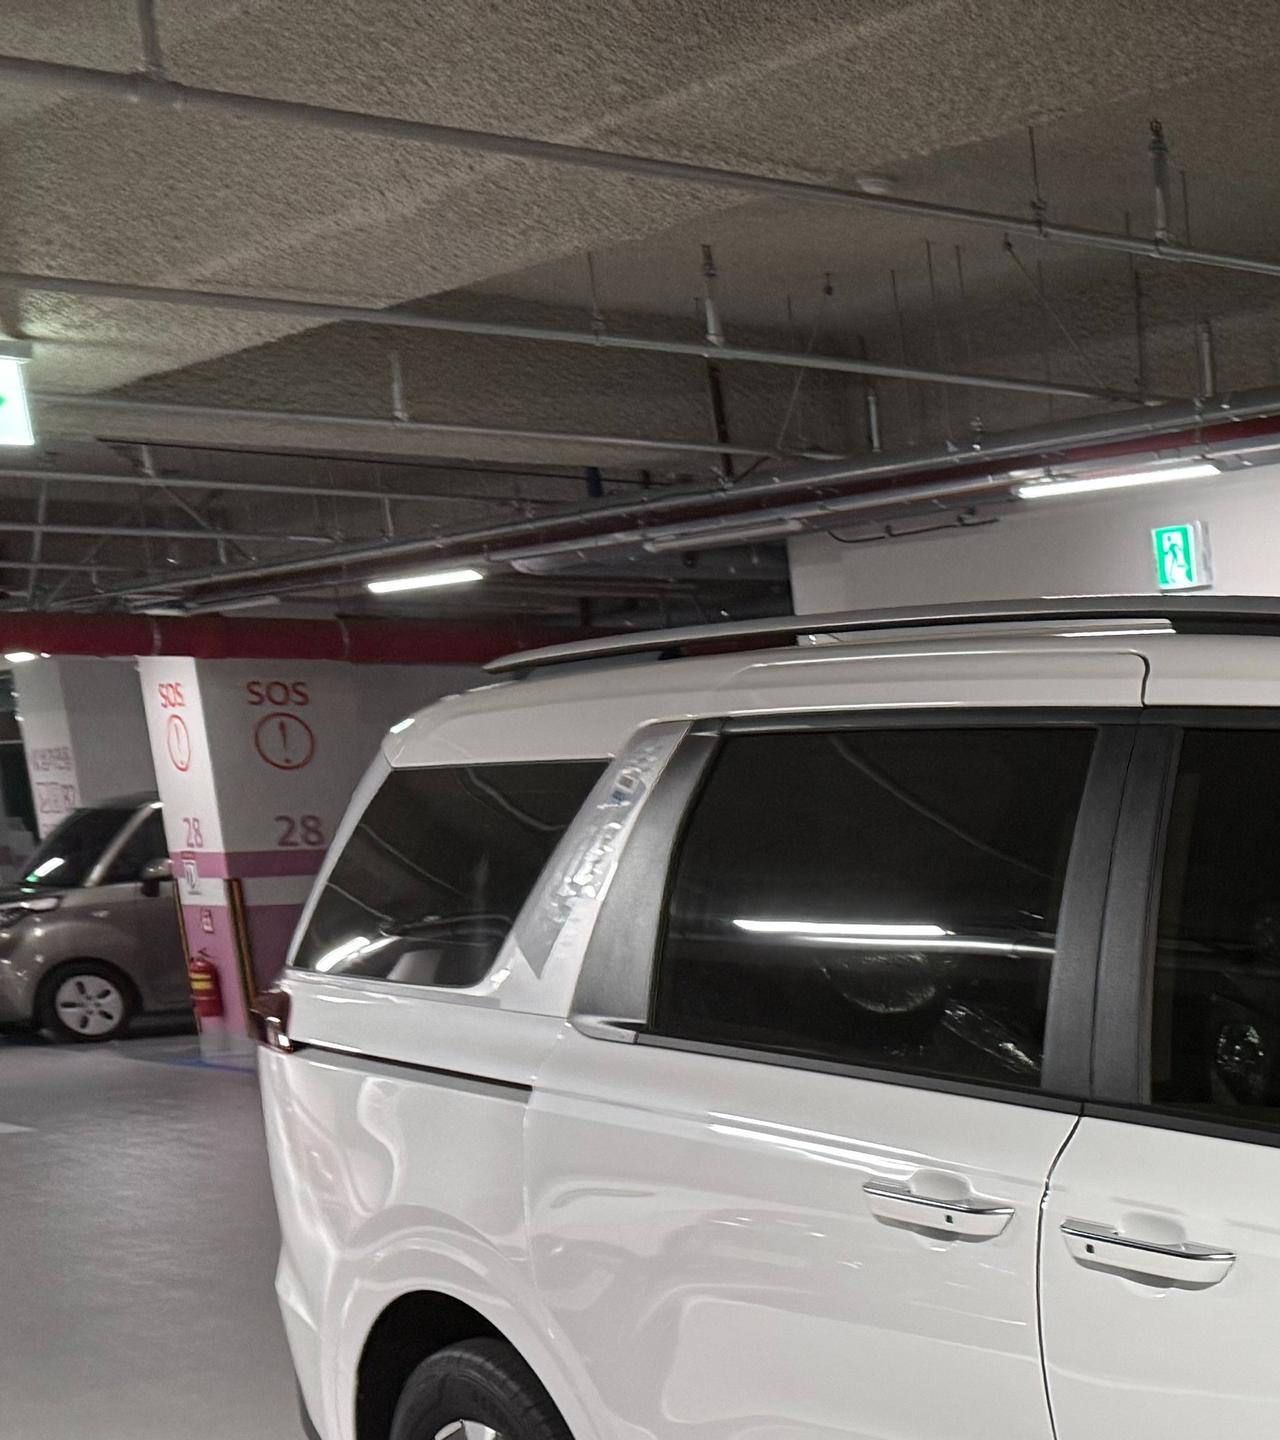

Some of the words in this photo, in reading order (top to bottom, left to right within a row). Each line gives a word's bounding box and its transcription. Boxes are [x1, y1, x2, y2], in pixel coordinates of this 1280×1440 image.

[157, 682, 187, 708] SOS
[246, 680, 311, 706] SOS
[182, 817, 205, 849] 28
[274, 814, 326, 848] 28
